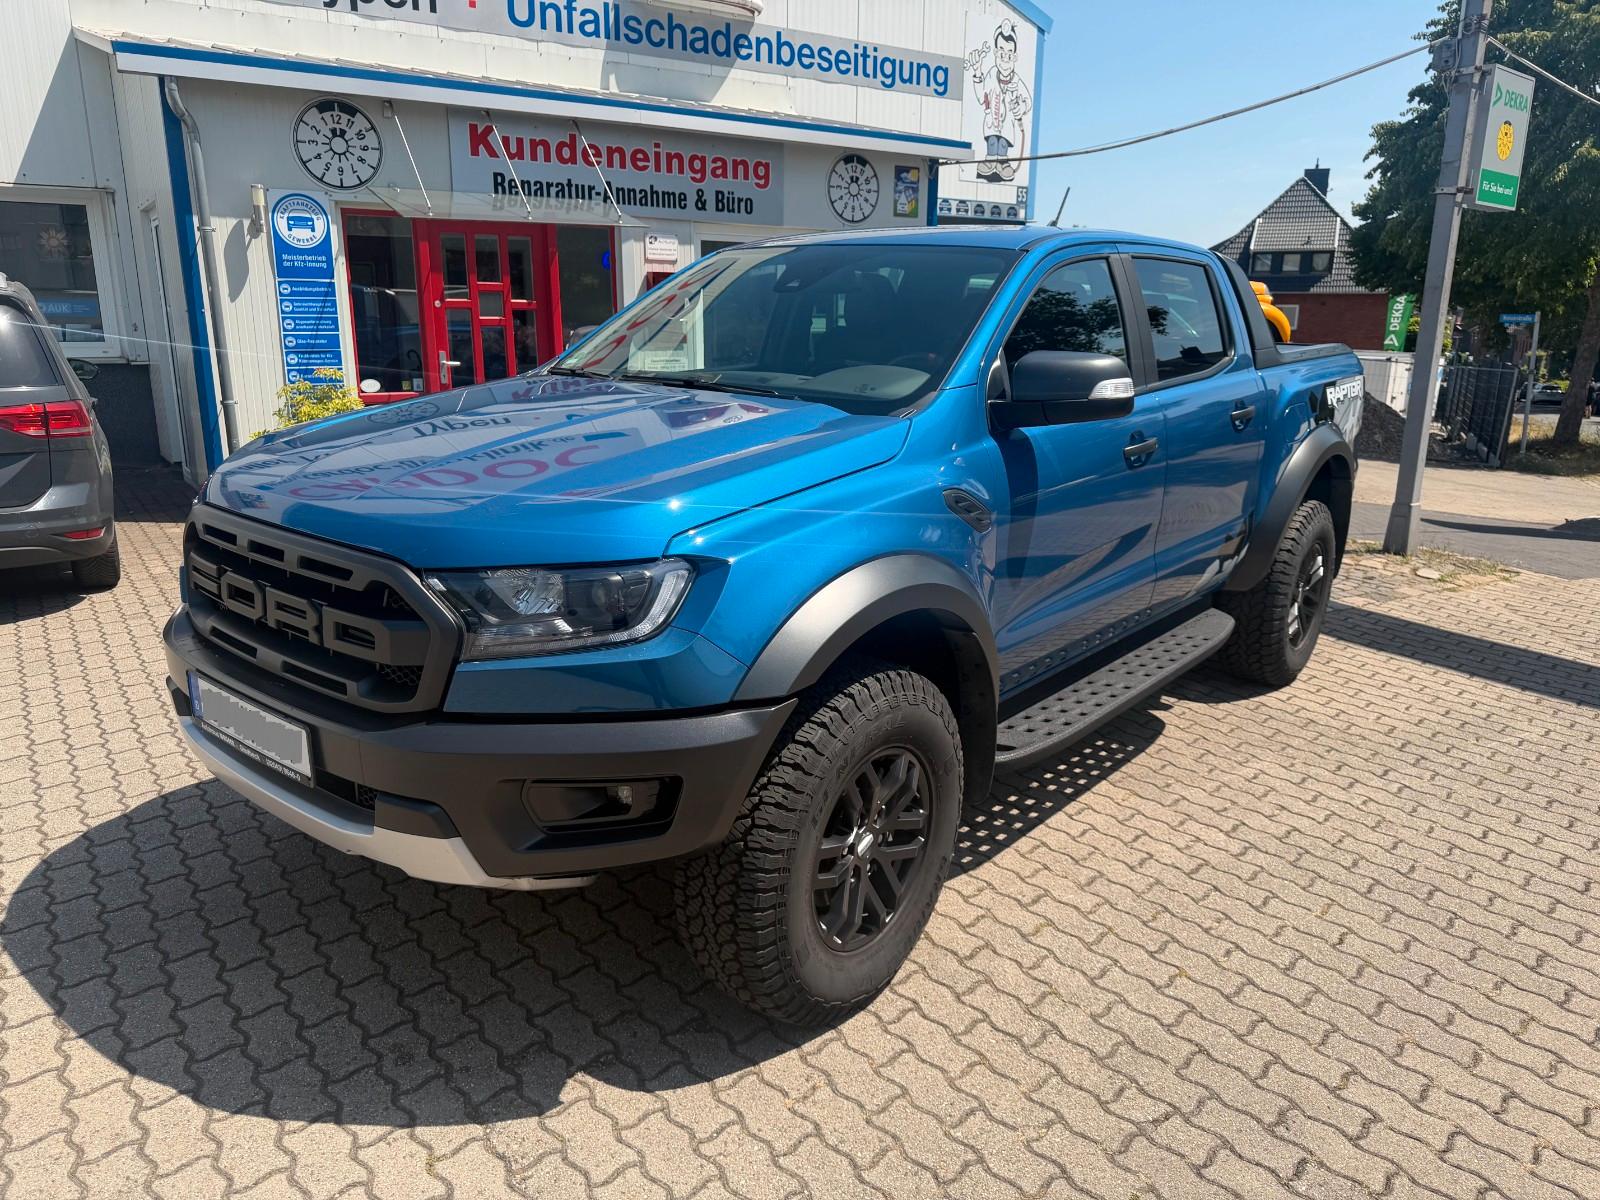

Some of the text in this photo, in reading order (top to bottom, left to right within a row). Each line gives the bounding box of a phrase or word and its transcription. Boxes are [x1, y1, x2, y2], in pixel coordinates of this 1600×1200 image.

[507, 0, 949, 96] Unfallschadenbeseitigung
[1504, 88, 1528, 113] DEKRA
[320, 115, 328, 126] 1
[330, 113, 342, 124] 12
[345, 118, 354, 129] 11
[311, 125, 321, 135] 2
[355, 129, 366, 140] 10
[313, 152, 322, 160] 4
[357, 155, 366, 164] 8
[468, 122, 771, 190] Kundeneingang
[324, 161, 332, 172] 5
[337, 166, 344, 176] 6
[350, 163, 358, 174] 7
[694, 188, 708, 212] &
[714, 190, 754, 215] Büro
[282, 253, 327, 262] Meisterbetrieb
[294, 261, 327, 269] Kfz-Innung
[1390, 294, 1408, 331] DEKRA
[1325, 380, 1362, 409] RAPTOR
[189, 552, 392, 666] FORD
